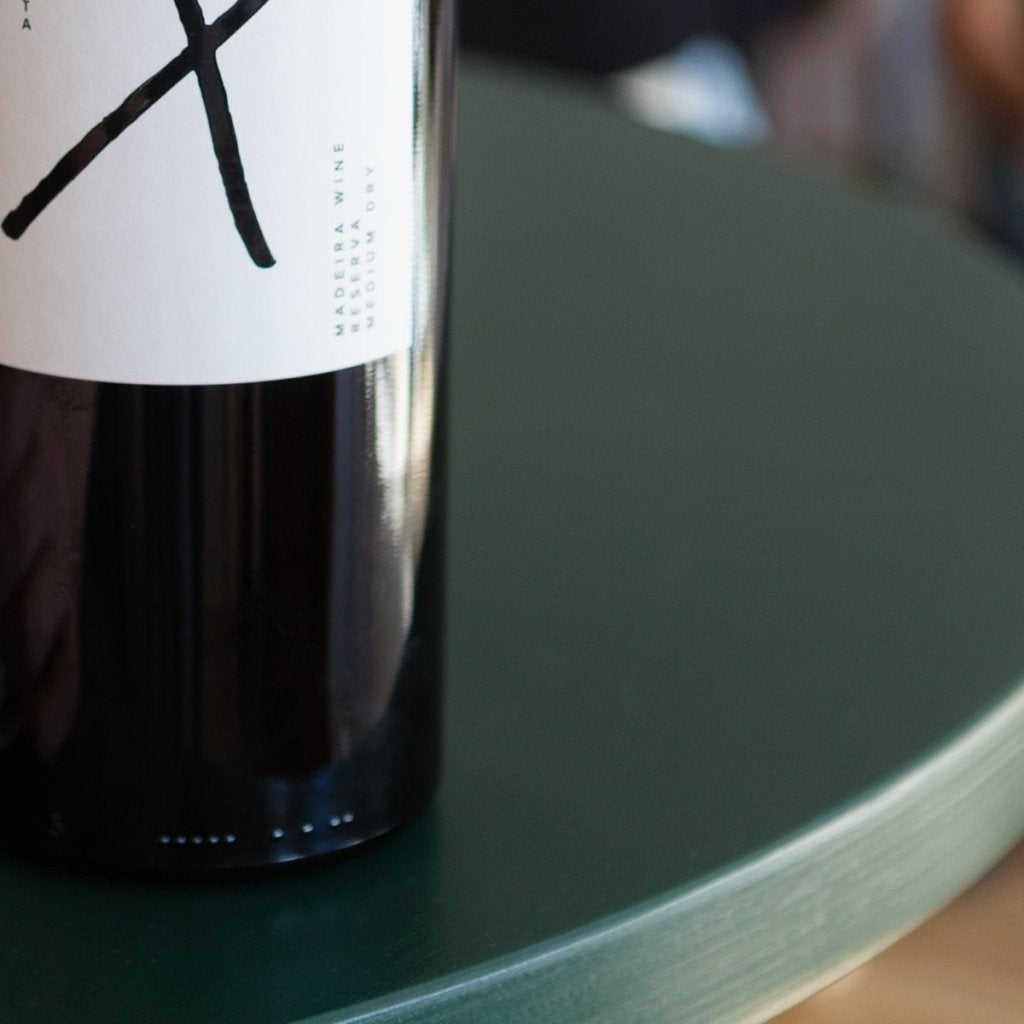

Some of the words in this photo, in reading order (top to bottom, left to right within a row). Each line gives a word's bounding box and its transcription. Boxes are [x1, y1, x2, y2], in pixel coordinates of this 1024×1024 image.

[333, 143, 344, 205] WINE
[365, 166, 375, 212] DRY
[333, 223, 345, 336] MADEIRA
[350, 219, 360, 332] RESERVA
[366, 231, 375, 328] MEDIUM
